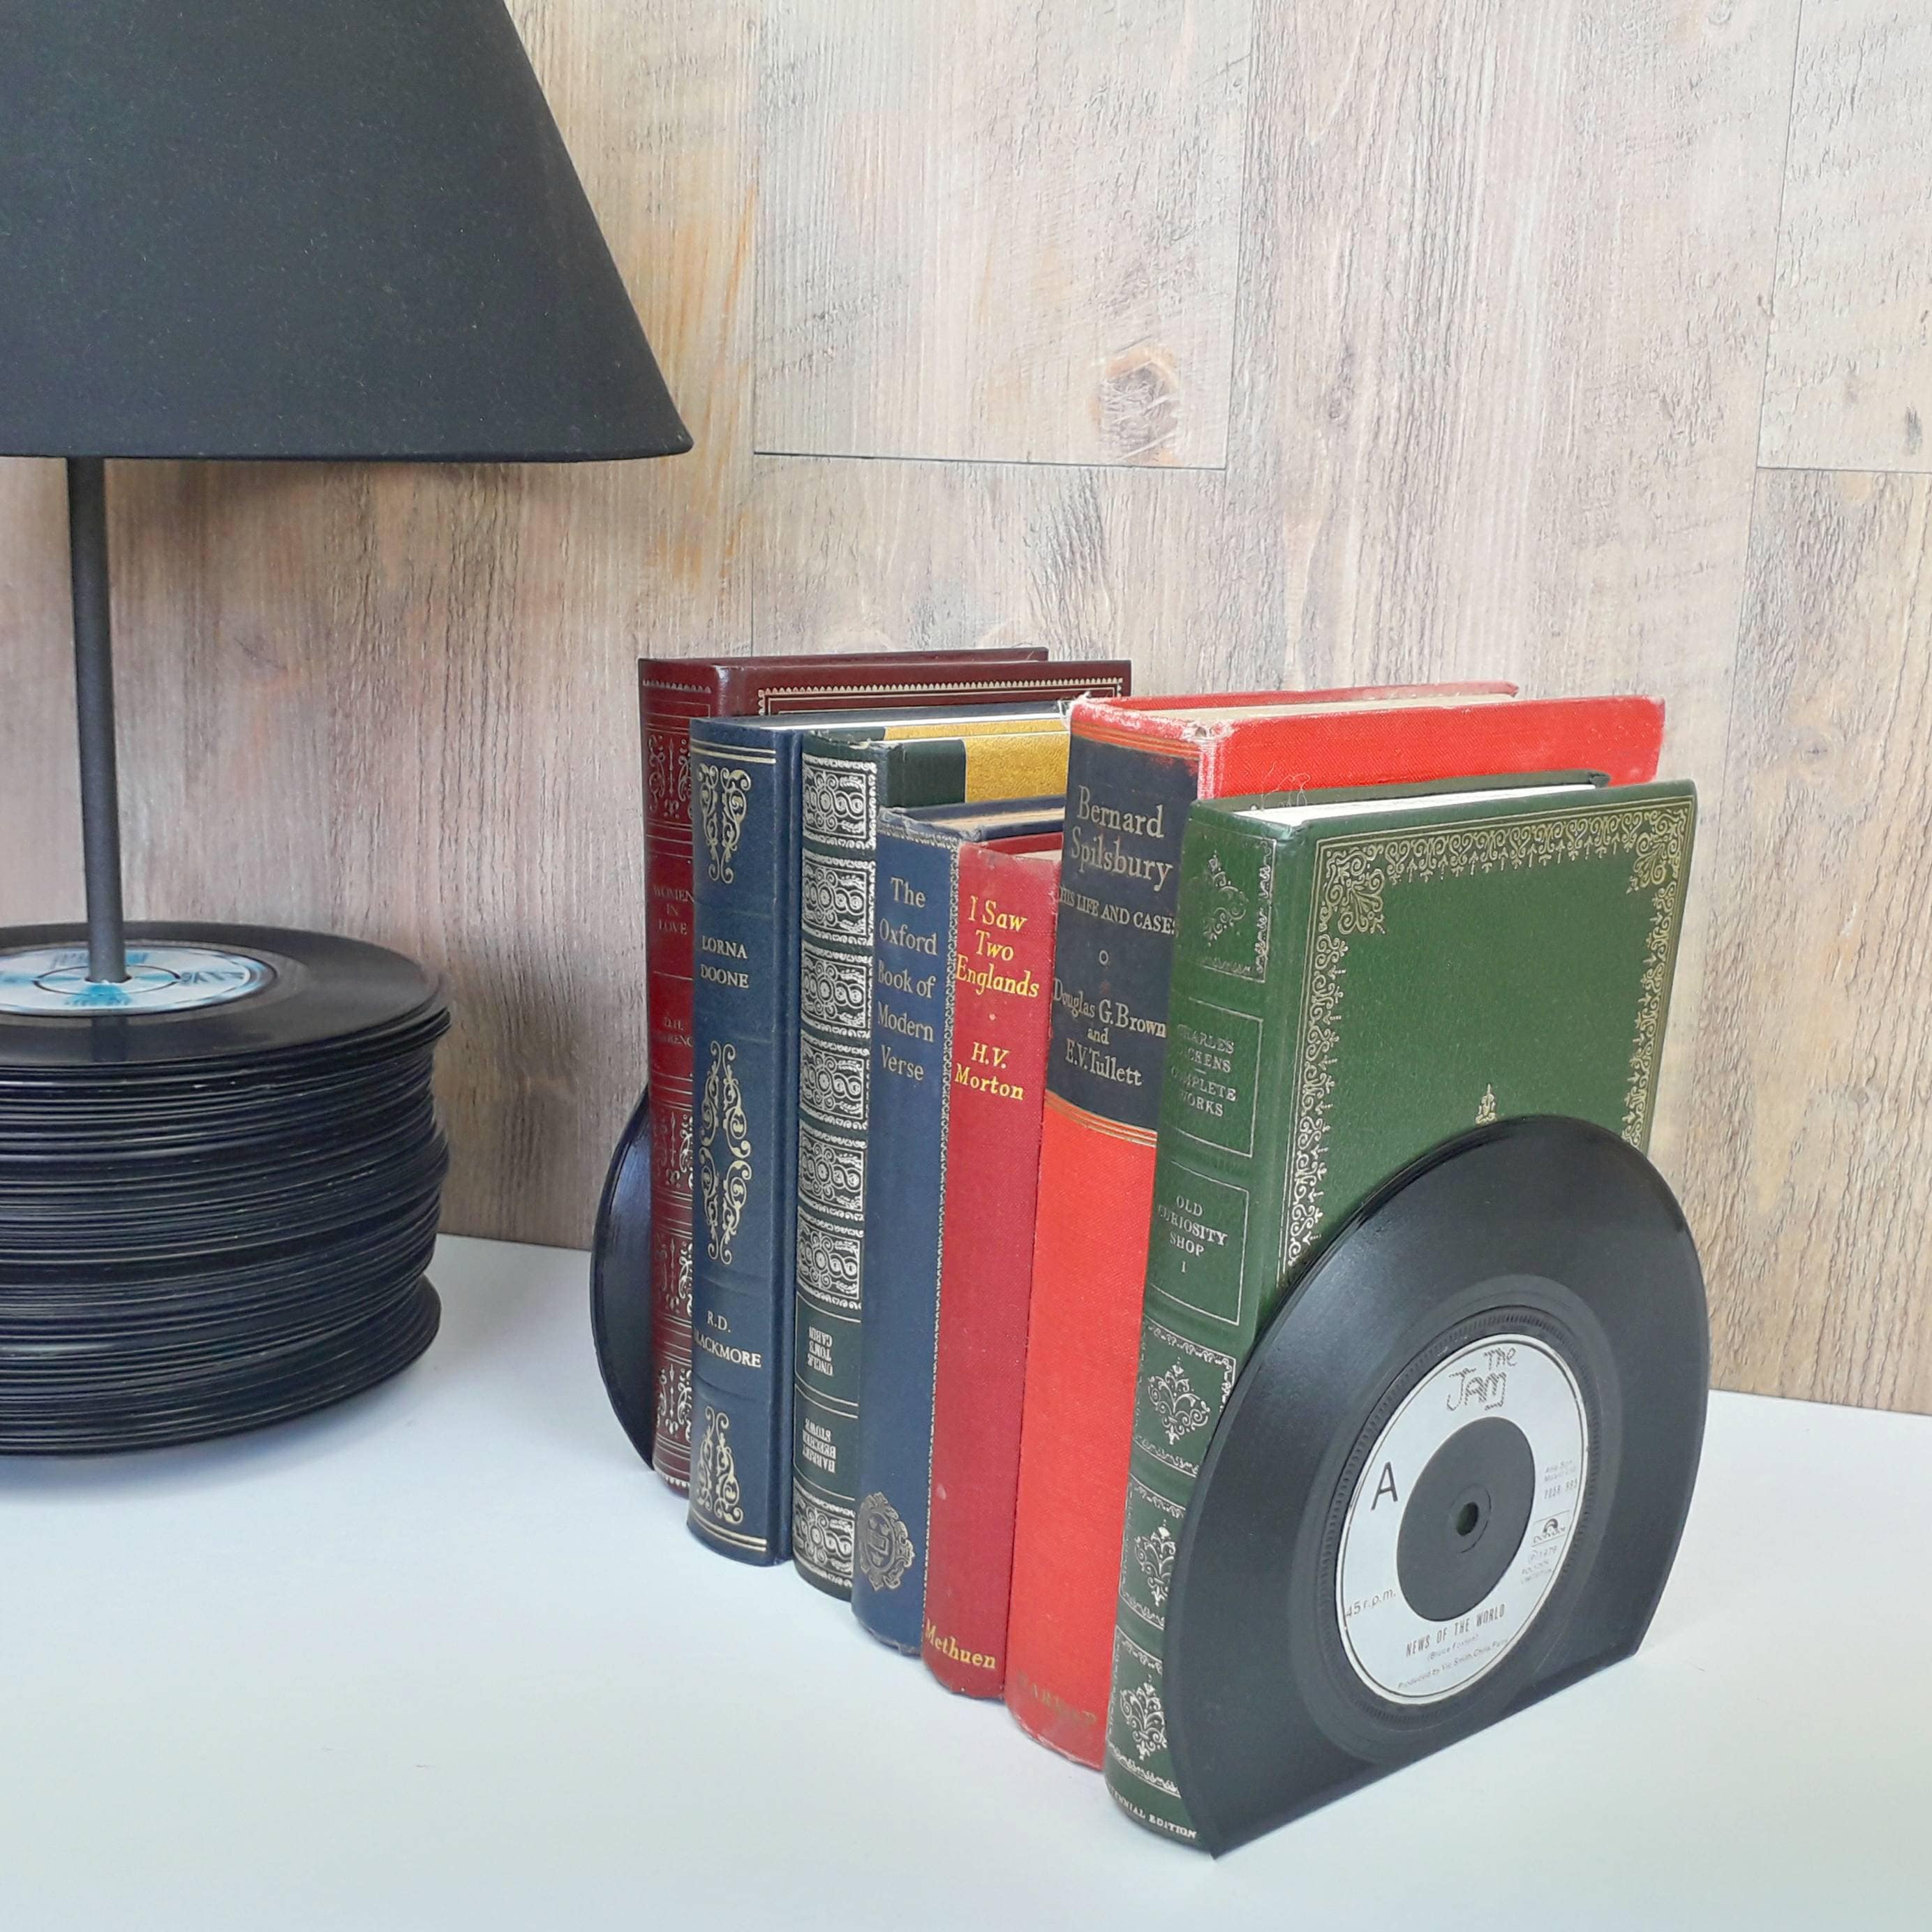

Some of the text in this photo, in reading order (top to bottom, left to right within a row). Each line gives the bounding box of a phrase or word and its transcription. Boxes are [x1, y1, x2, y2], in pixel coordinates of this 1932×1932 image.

[1077, 785, 1164, 838] Bernard
[1071, 826, 1173, 892] Spilsbury
[891, 877, 926, 907] The
[1076, 893, 1100, 917] LIFE
[1101, 904, 1130, 925] AND
[968, 896, 1027, 932] I Saw
[701, 935, 748, 960] LORNA
[879, 919, 937, 956] Oxford
[976, 930, 1014, 961] Two
[701, 964, 750, 989] DOONE
[878, 960, 937, 998] Book of
[956, 954, 1040, 997] Englands
[1054, 978, 1095, 1018] Douglas
[877, 1001, 934, 1042] Modern
[1087, 1028, 1110, 1045] and
[882, 1045, 925, 1080] Verse
[972, 1042, 1010, 1069] H.V.
[955, 1063, 1025, 1101] Morton
[1176, 1195, 1203, 1217] OLD
[1158, 1205, 1228, 1246] CURIOSITY
[1170, 1231, 1205, 1257] SHOP
[707, 1311, 731, 1332] R.D.
[1370, 1461, 1399, 1511] A
[924, 1620, 997, 1669] Methuen
[1406, 1604, 1506, 1658] NEWS OF THE WORLD
[1149, 1814, 1197, 1840] EDITION
